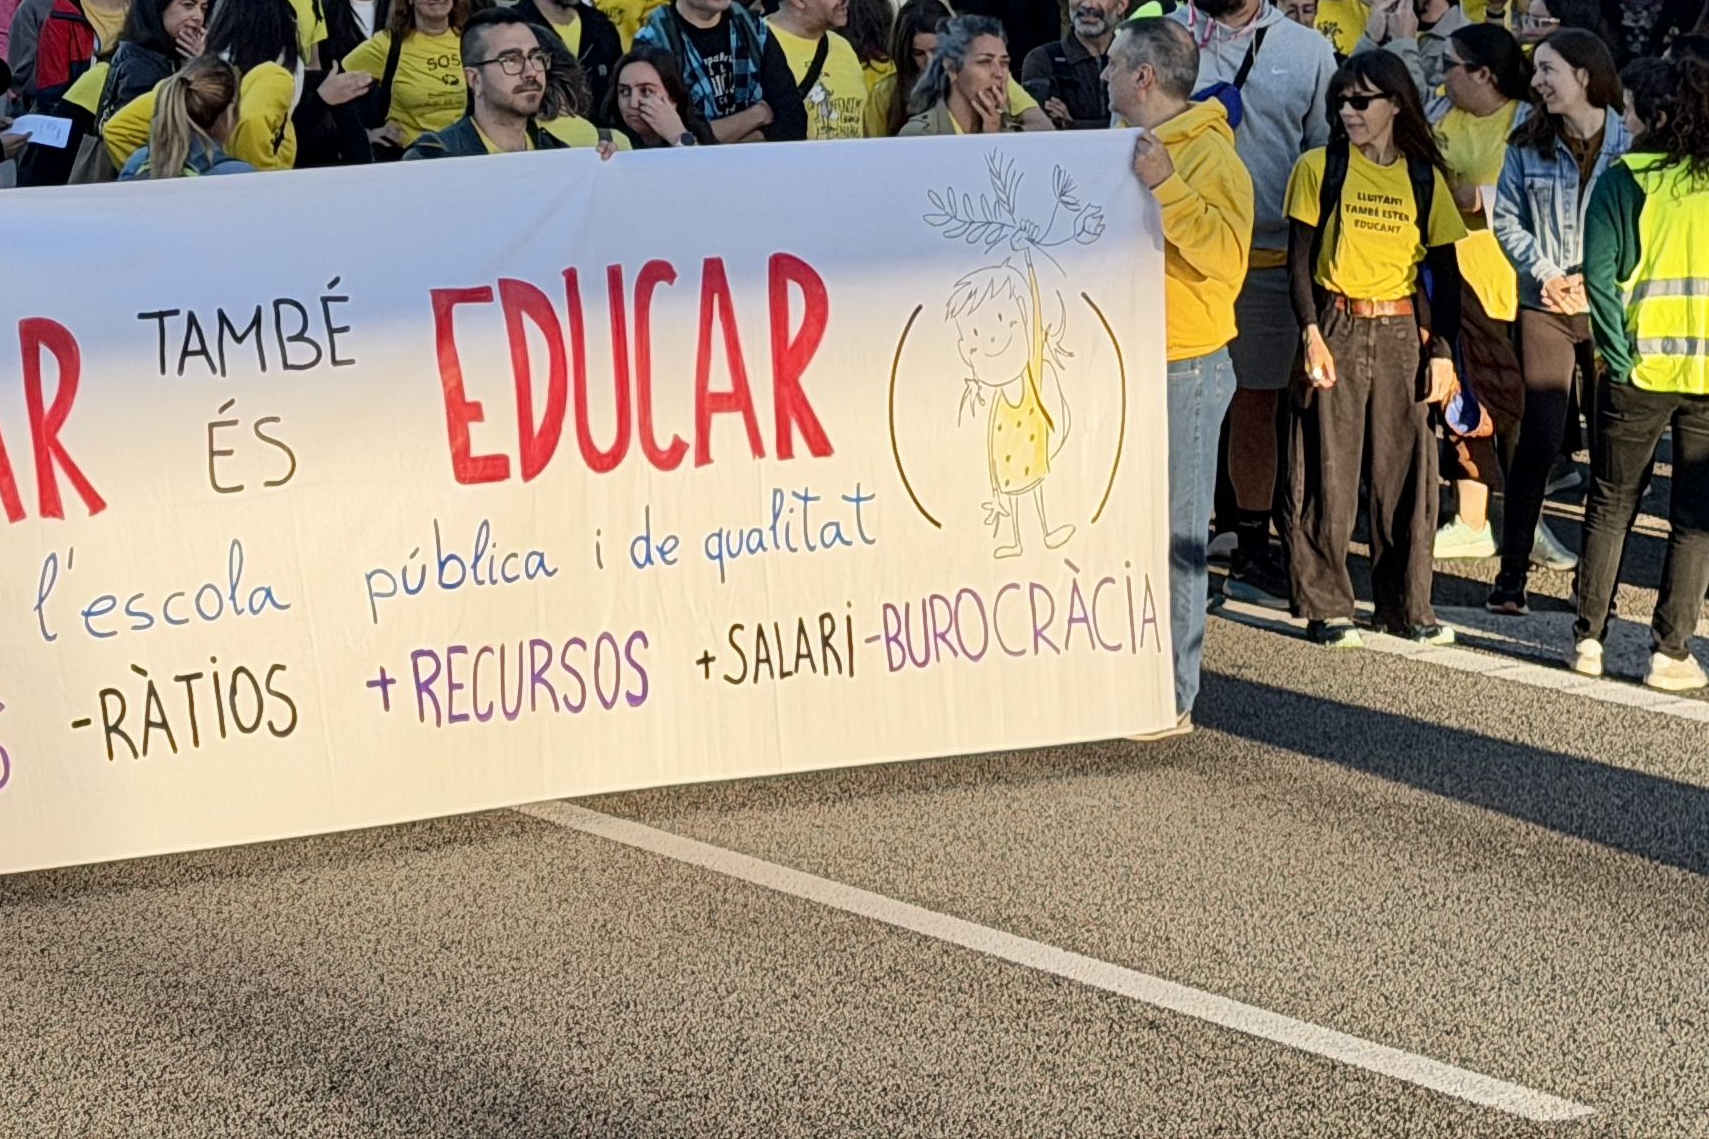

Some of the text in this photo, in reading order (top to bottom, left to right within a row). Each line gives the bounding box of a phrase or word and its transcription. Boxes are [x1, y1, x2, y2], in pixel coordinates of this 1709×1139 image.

[1354, 218, 1402, 234] EDUCANT
[137, 276, 356, 378] TAMBÉ
[430, 252, 835, 485] EDUCAR
[208, 398, 297, 494] ÉS
[33, 538, 292, 642] l'escola
[364, 518, 559, 626] pública
[594, 527, 605, 571] i
[630, 507, 681, 570] de
[705, 482, 877, 585] qualitat
